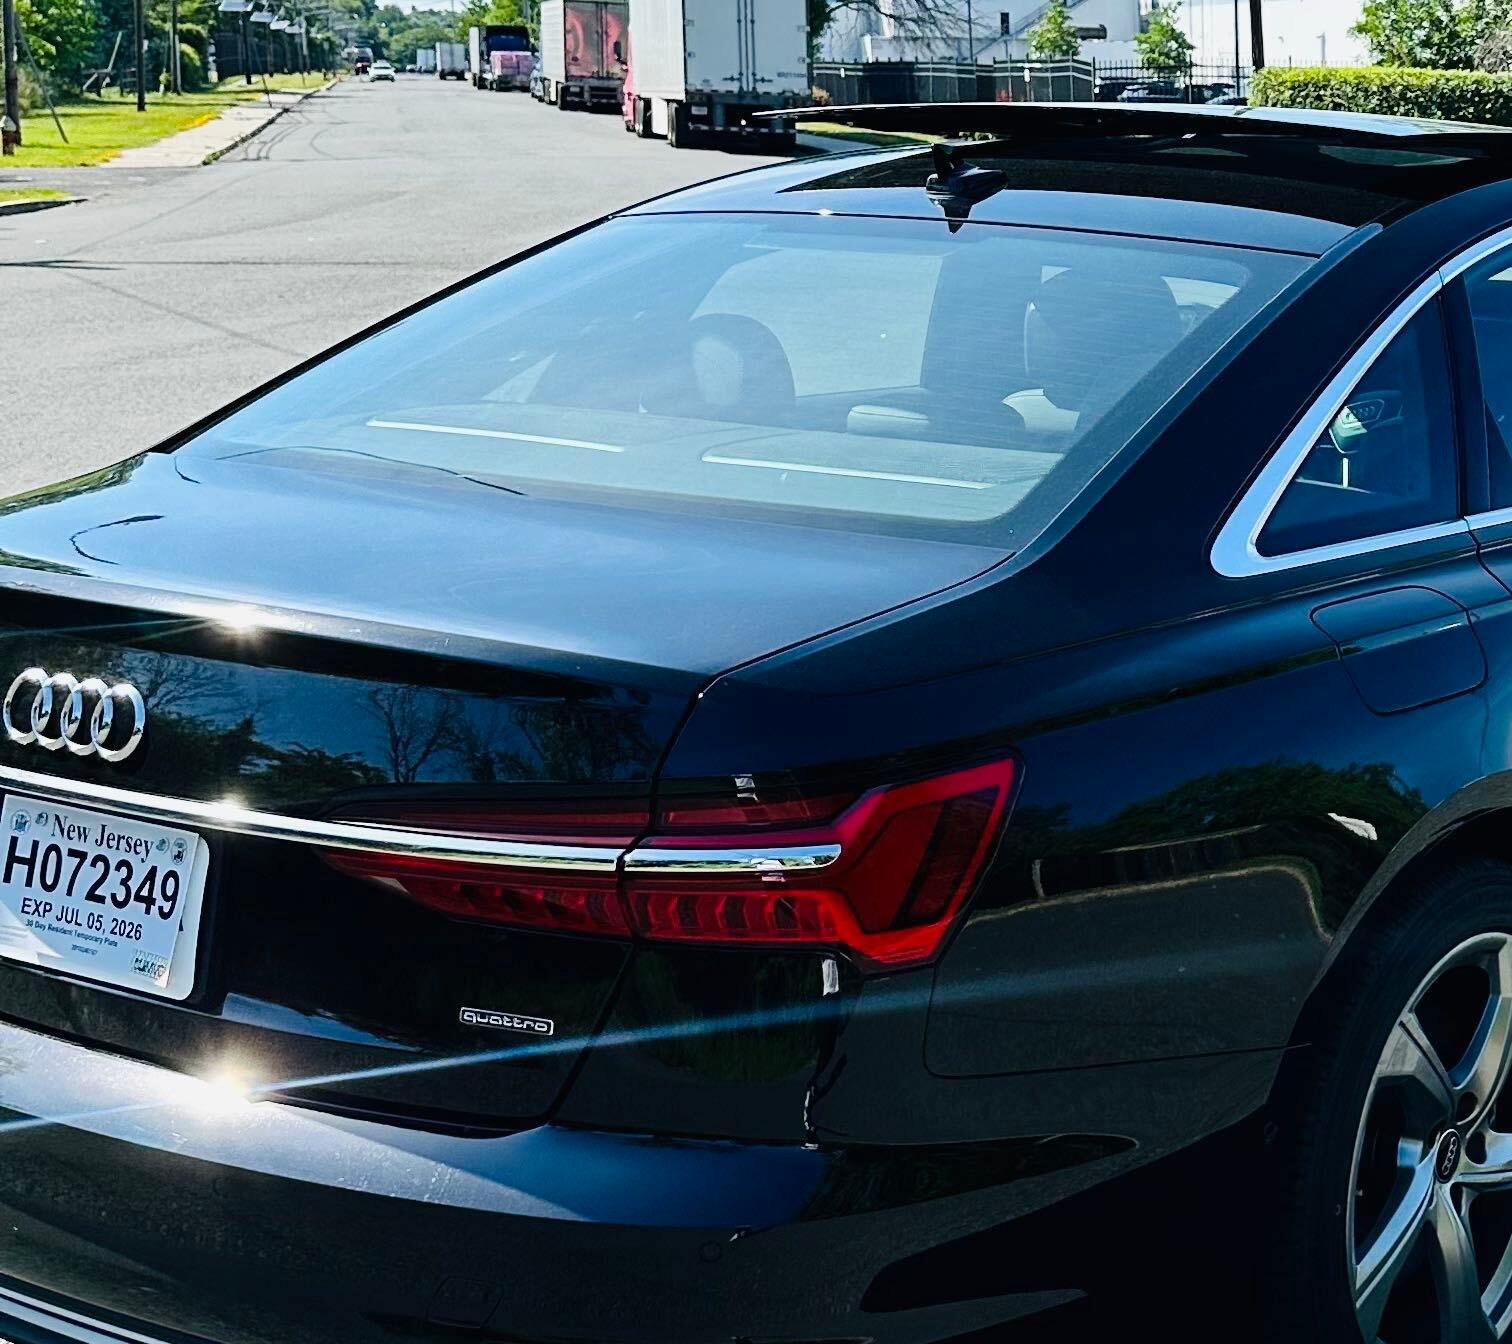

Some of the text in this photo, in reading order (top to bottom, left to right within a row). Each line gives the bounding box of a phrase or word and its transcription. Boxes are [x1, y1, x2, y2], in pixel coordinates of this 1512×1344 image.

[51, 813, 154, 863] New Jersey
[2, 835, 180, 920] H072349
[20, 897, 143, 941] EXP JUL 05, 2026
[463, 1011, 548, 1032] quattro
